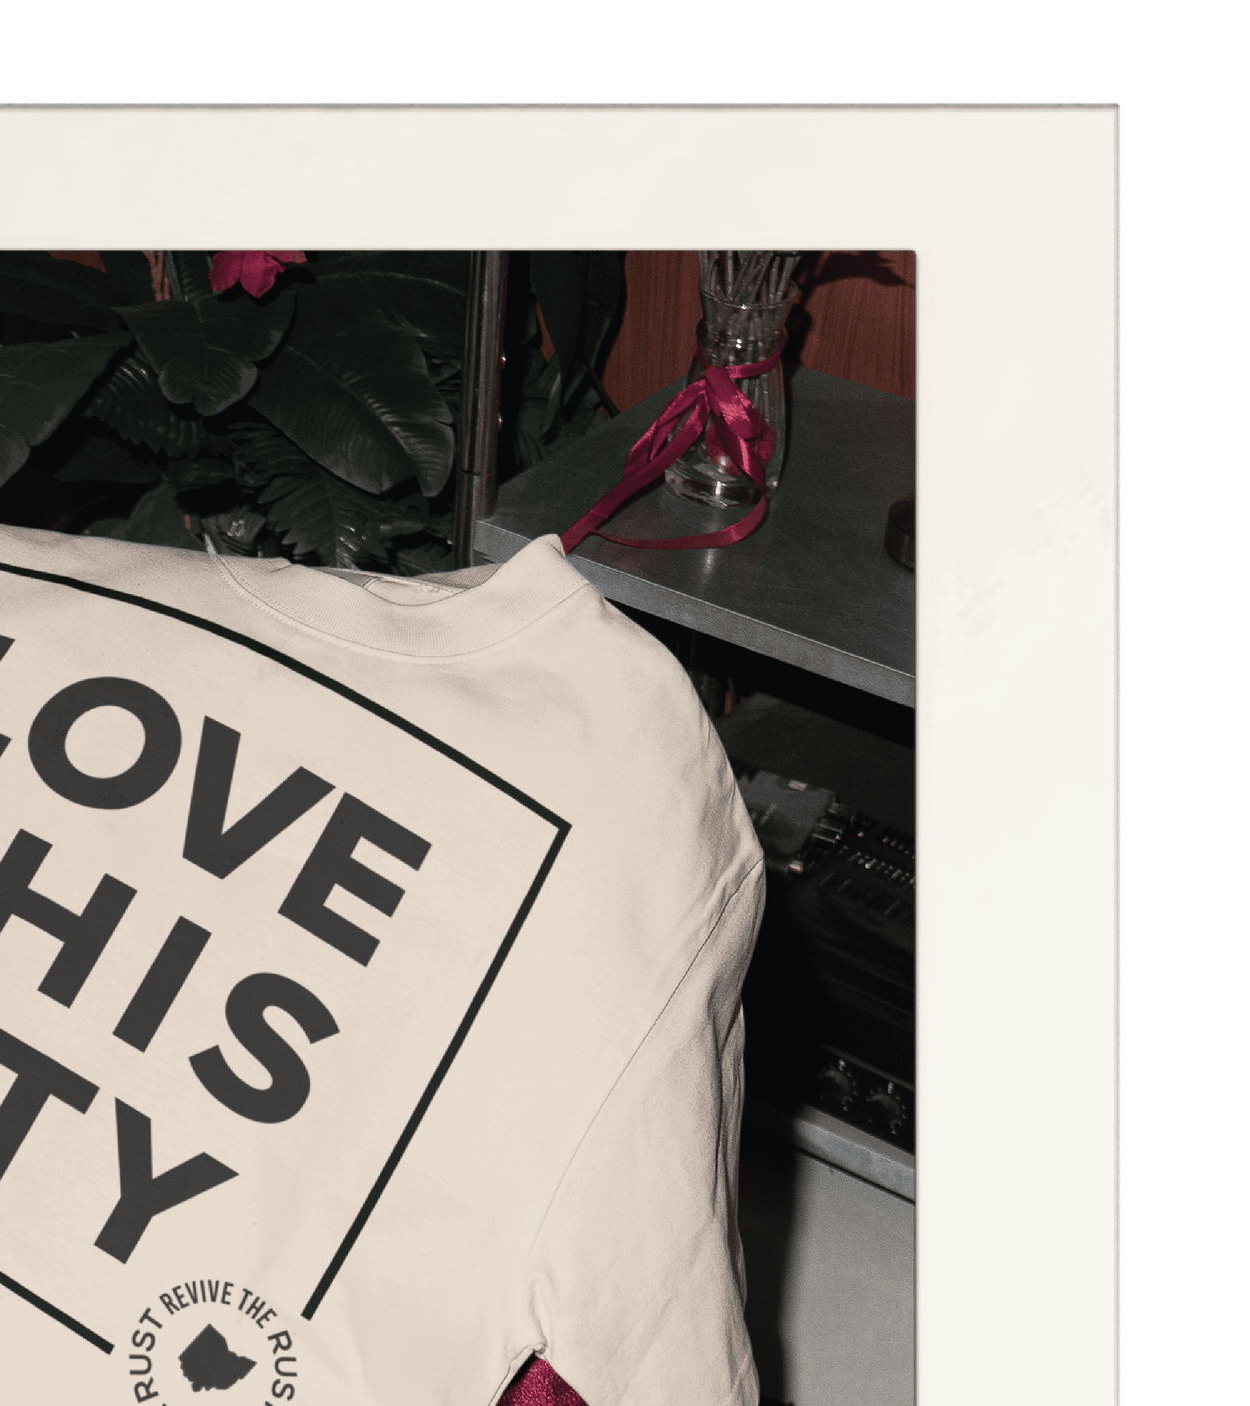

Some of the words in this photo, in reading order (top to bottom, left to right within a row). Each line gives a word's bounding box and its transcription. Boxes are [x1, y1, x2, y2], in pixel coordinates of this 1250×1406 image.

[159, 1279, 234, 1315] REVIVE
[237, 1288, 278, 1329] THE
[128, 1307, 163, 1404] RUST
